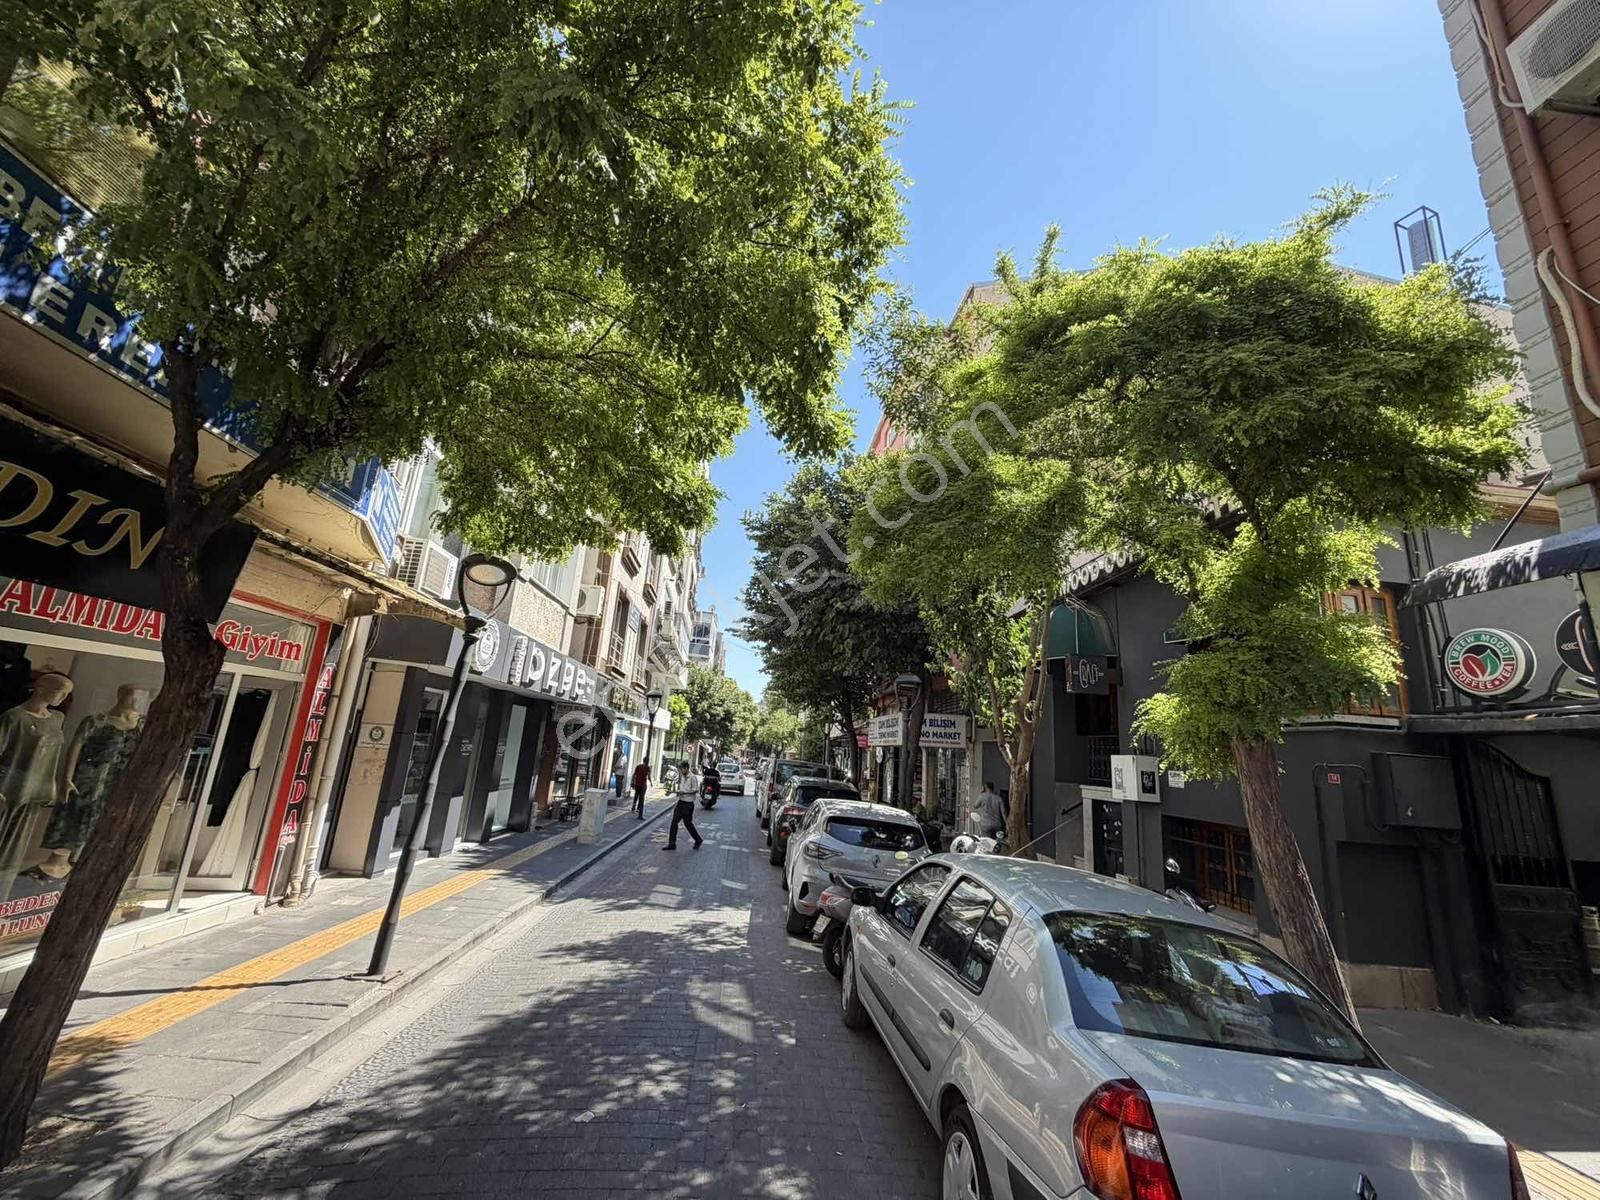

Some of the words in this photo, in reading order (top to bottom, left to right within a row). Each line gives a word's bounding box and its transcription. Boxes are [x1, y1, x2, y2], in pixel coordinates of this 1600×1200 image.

[214, 619, 302, 661] Giyim
[1451, 634, 1475, 658] BREW
[1480, 633, 1510, 654] MOOD
[1454, 668, 1495, 689] COFFEE
[1497, 664, 1514, 682] TEA
[931, 731, 962, 741] MARKET
